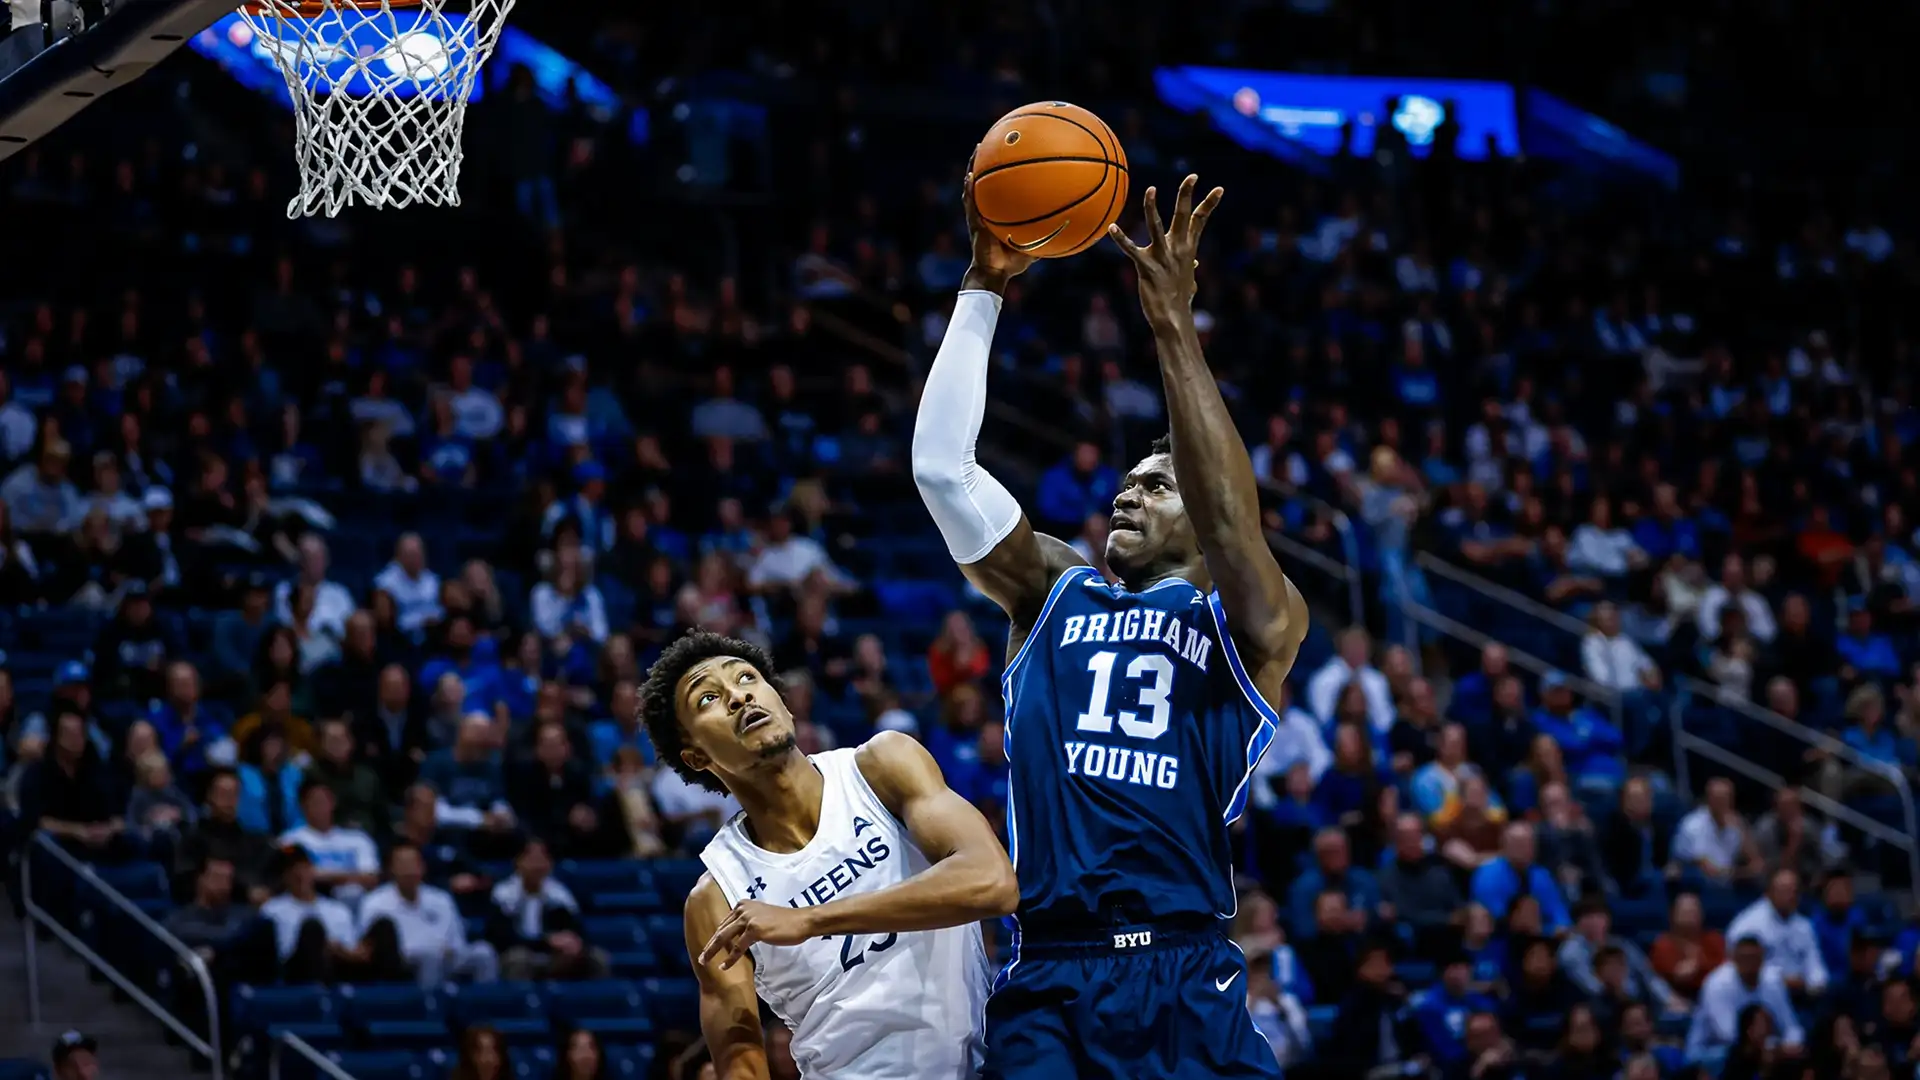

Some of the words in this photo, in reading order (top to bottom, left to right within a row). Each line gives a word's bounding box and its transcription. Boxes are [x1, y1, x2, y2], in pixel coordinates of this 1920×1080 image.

[1060, 609, 1212, 672] BRIGHAM
[1077, 650, 1174, 739] 13
[1064, 742, 1178, 789] YOUNG
[788, 836, 890, 908] UEENS
[1113, 931, 1151, 948] BYU
